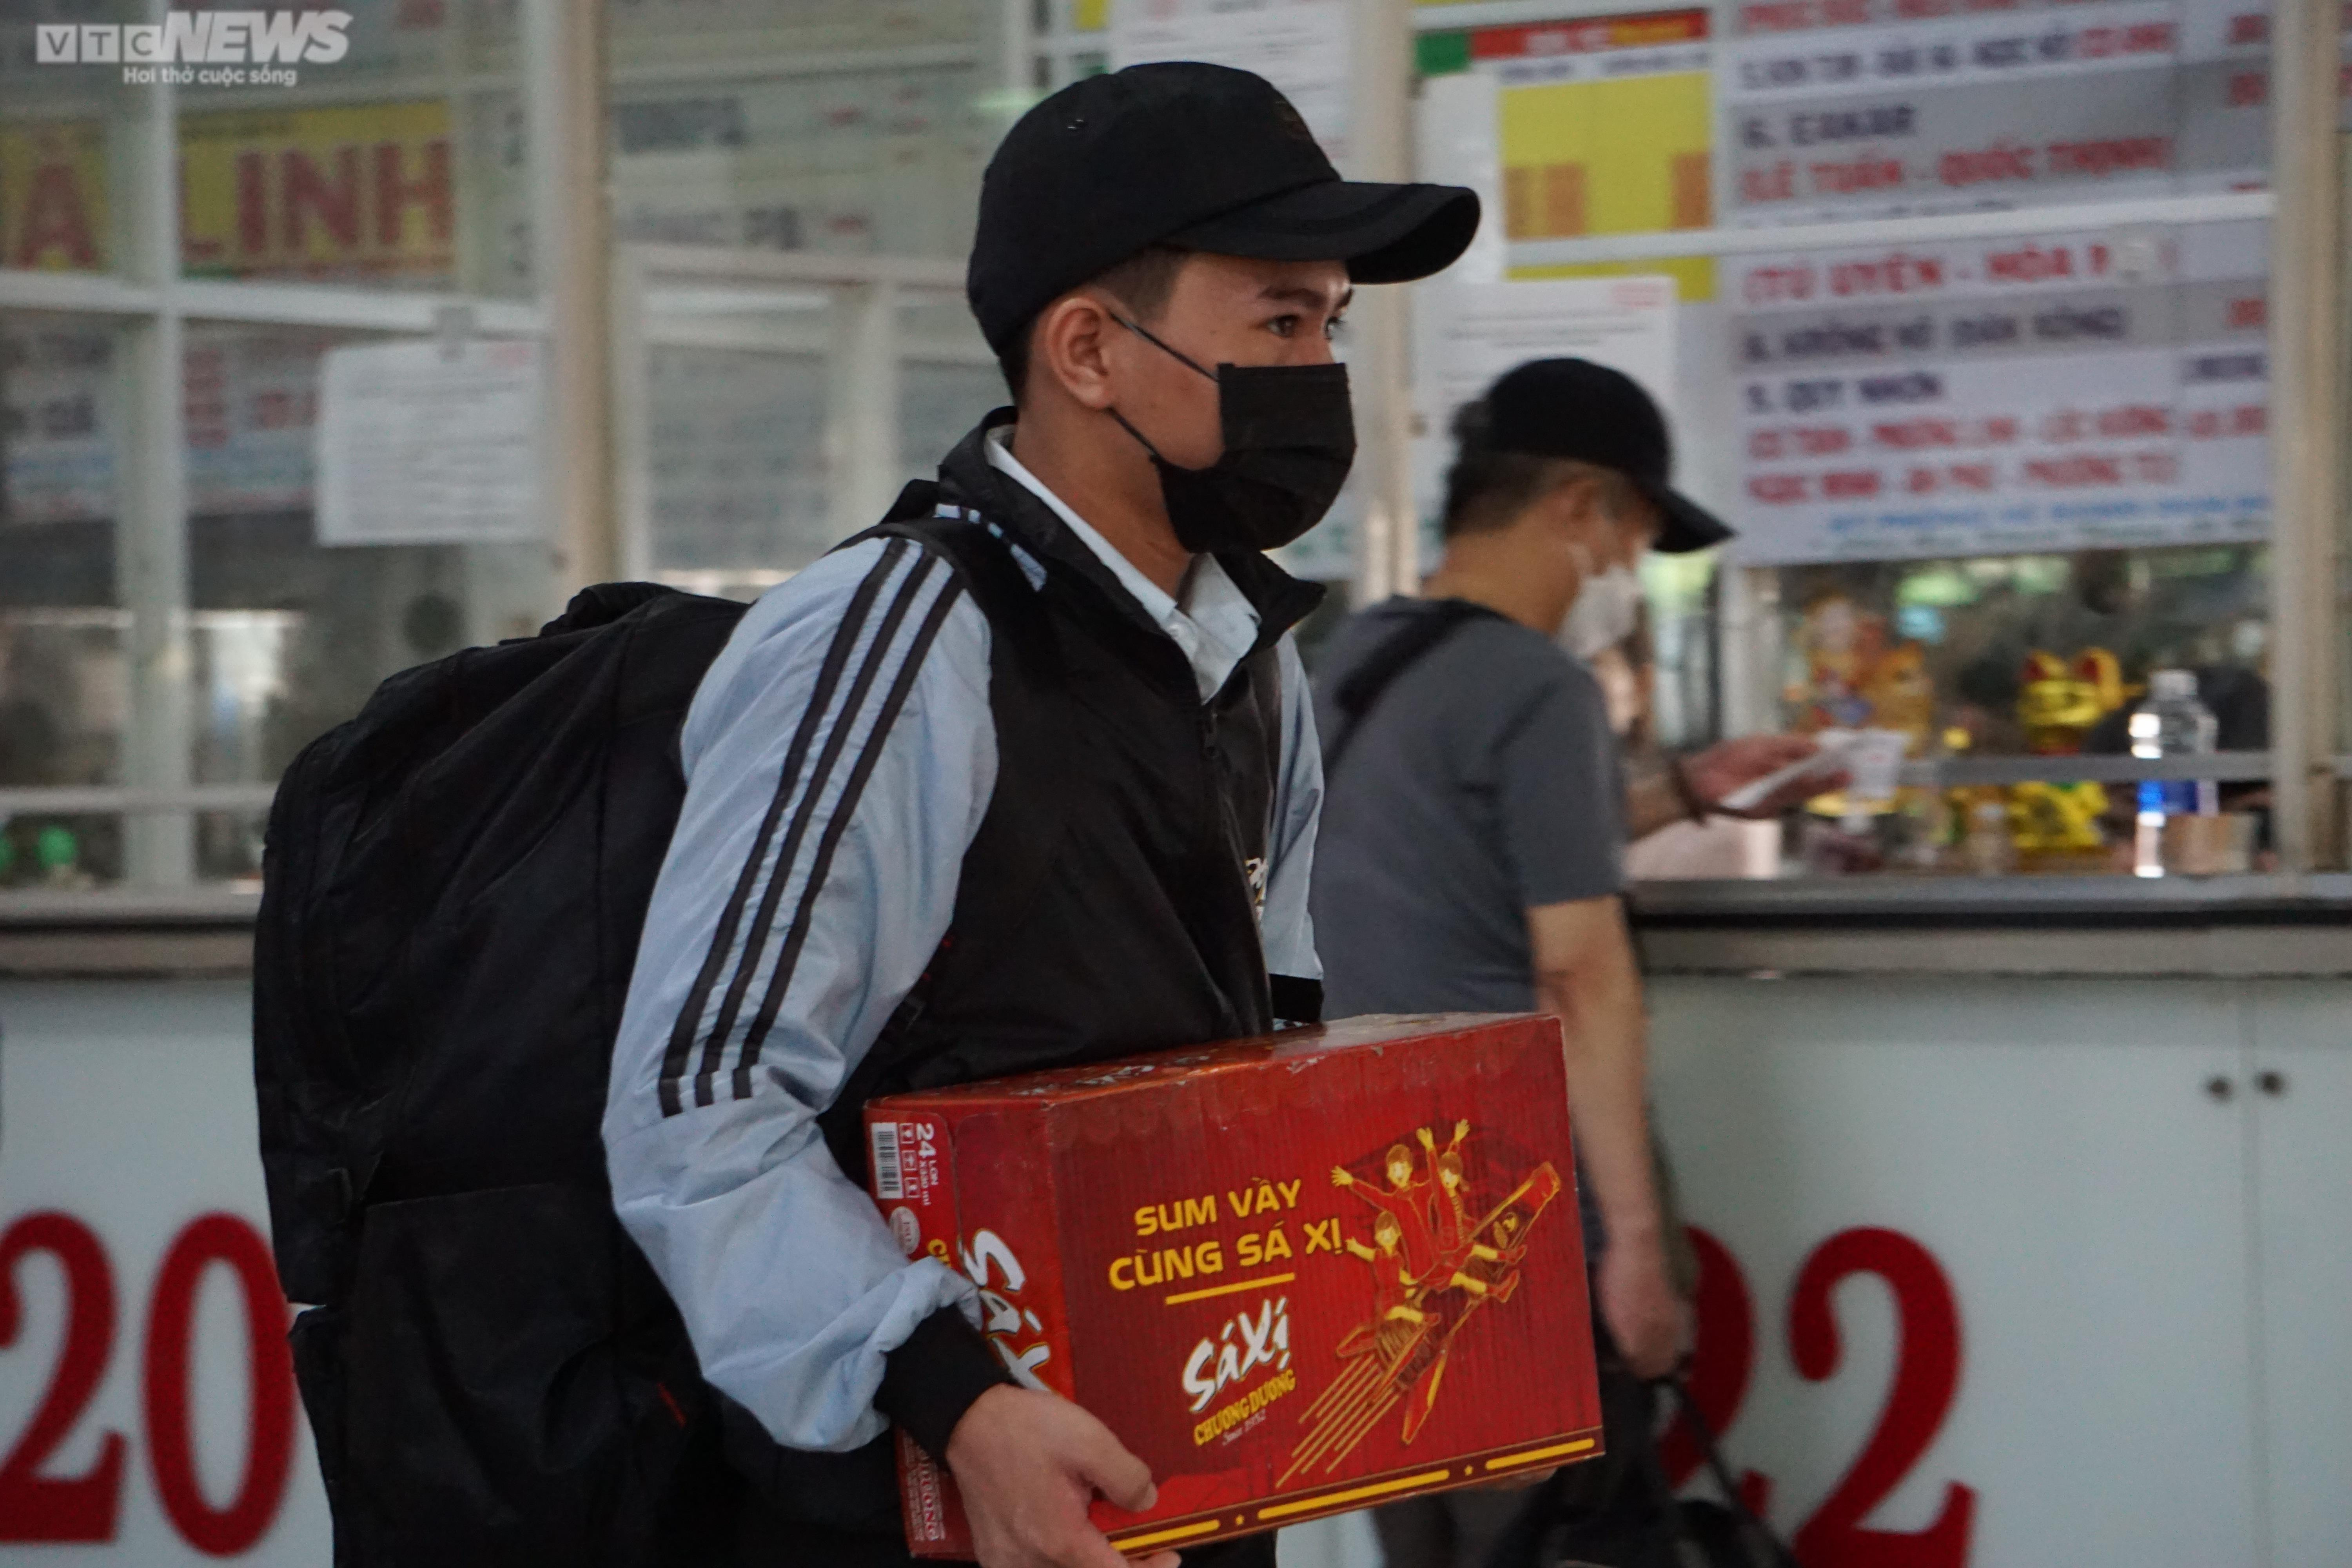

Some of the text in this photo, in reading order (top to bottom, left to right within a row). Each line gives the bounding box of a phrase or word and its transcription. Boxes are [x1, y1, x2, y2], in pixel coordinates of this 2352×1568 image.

[916, 1123, 937, 1158] 24
[928, 1160, 940, 1186] LON
[1134, 1176, 1301, 1236] SUM VẦY
[1108, 1241, 1224, 1291] CÙNG
[1236, 1220, 1293, 1267] SÁ
[0, 1208, 298, 1558] 20
